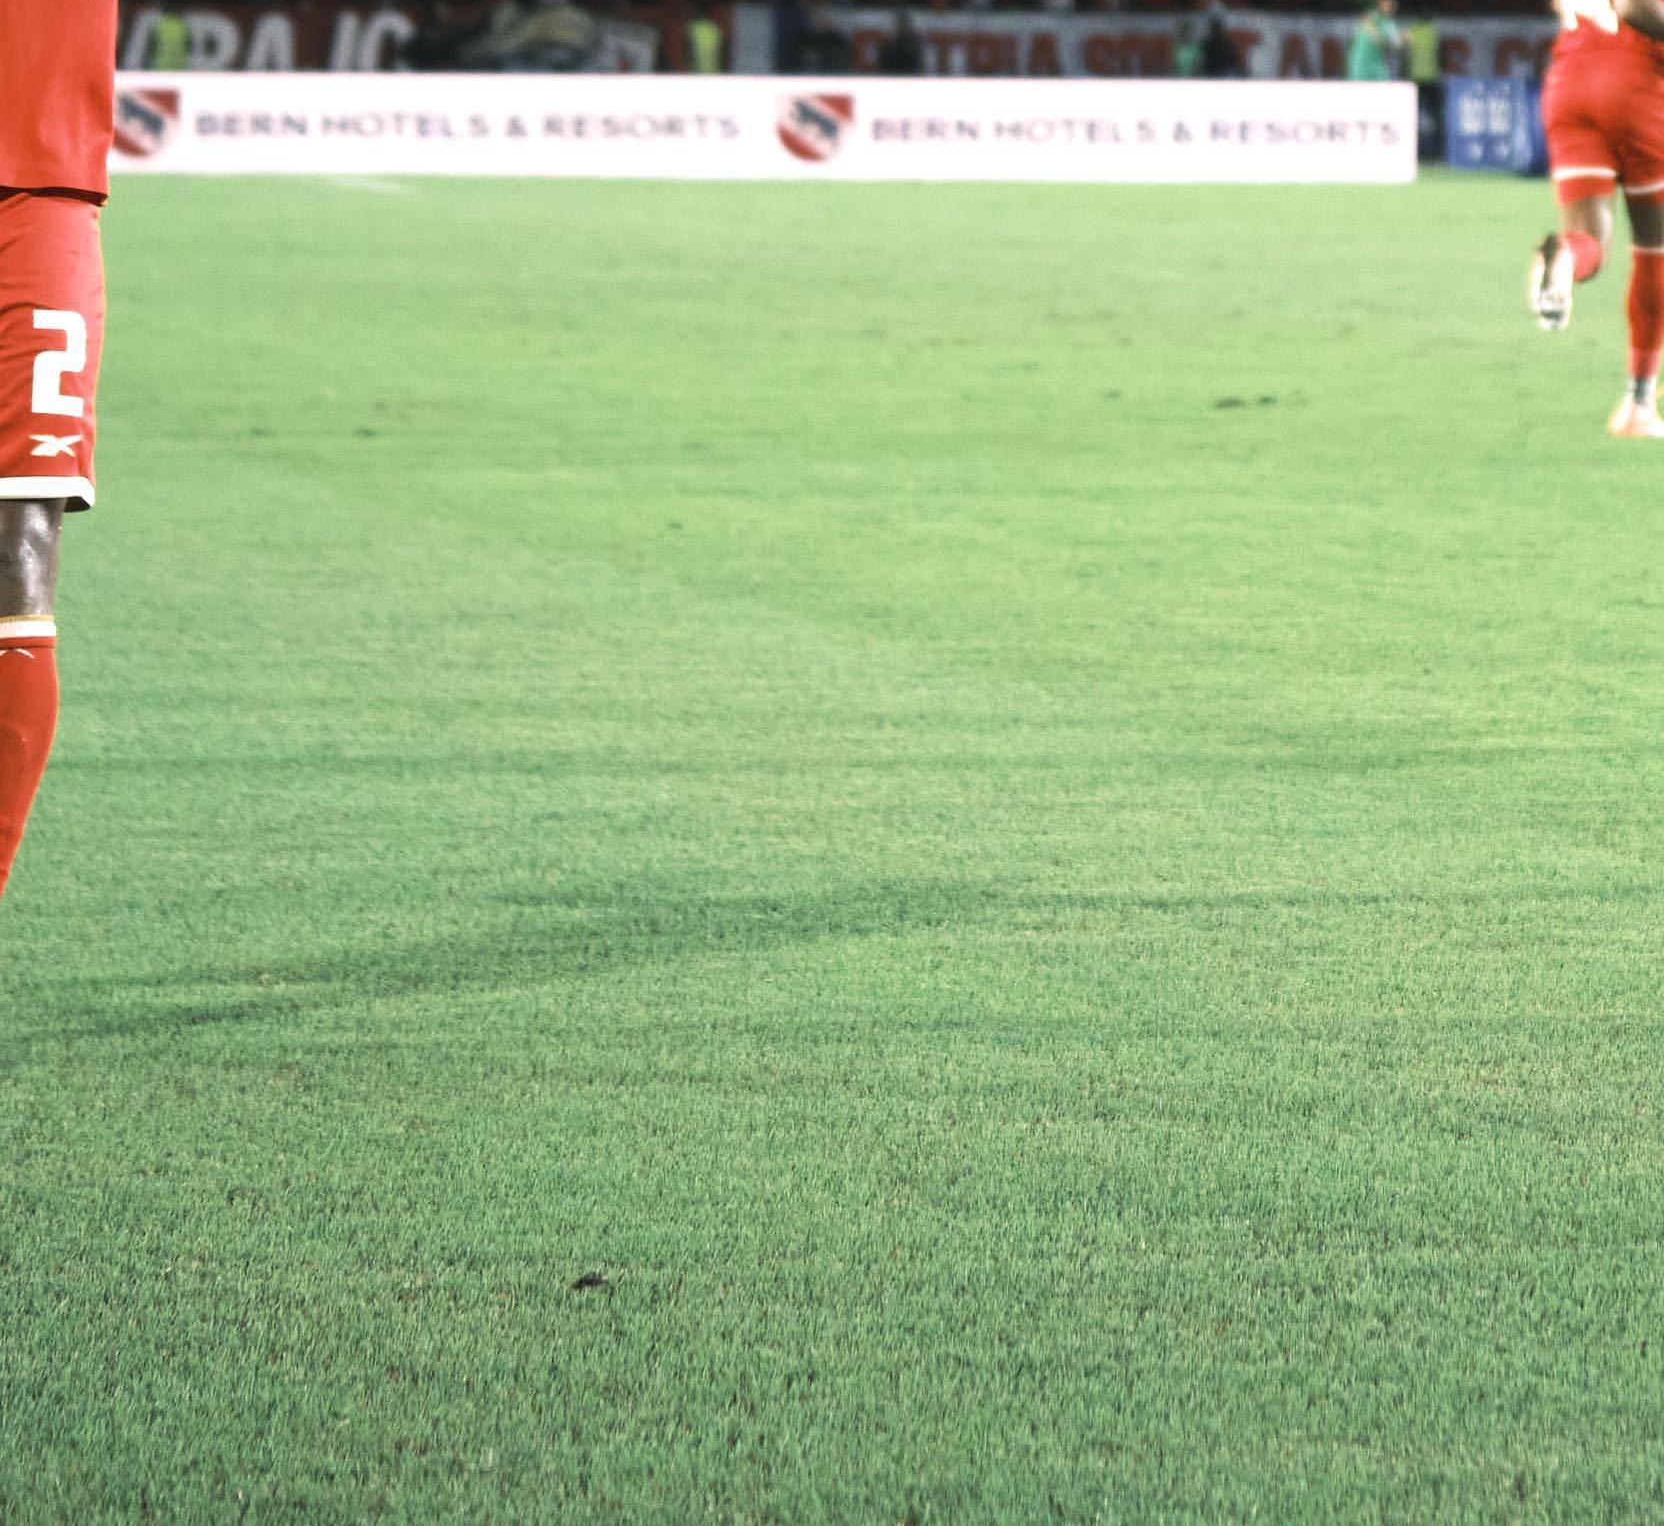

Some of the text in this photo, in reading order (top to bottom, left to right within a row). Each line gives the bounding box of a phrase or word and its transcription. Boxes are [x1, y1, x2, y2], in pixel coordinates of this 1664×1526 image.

[197, 113, 739, 138] BERN HOTELS & RESORTS
[871, 118, 1400, 145] BERN HOTELS & RESORTS
[31, 309, 86, 417] 2
